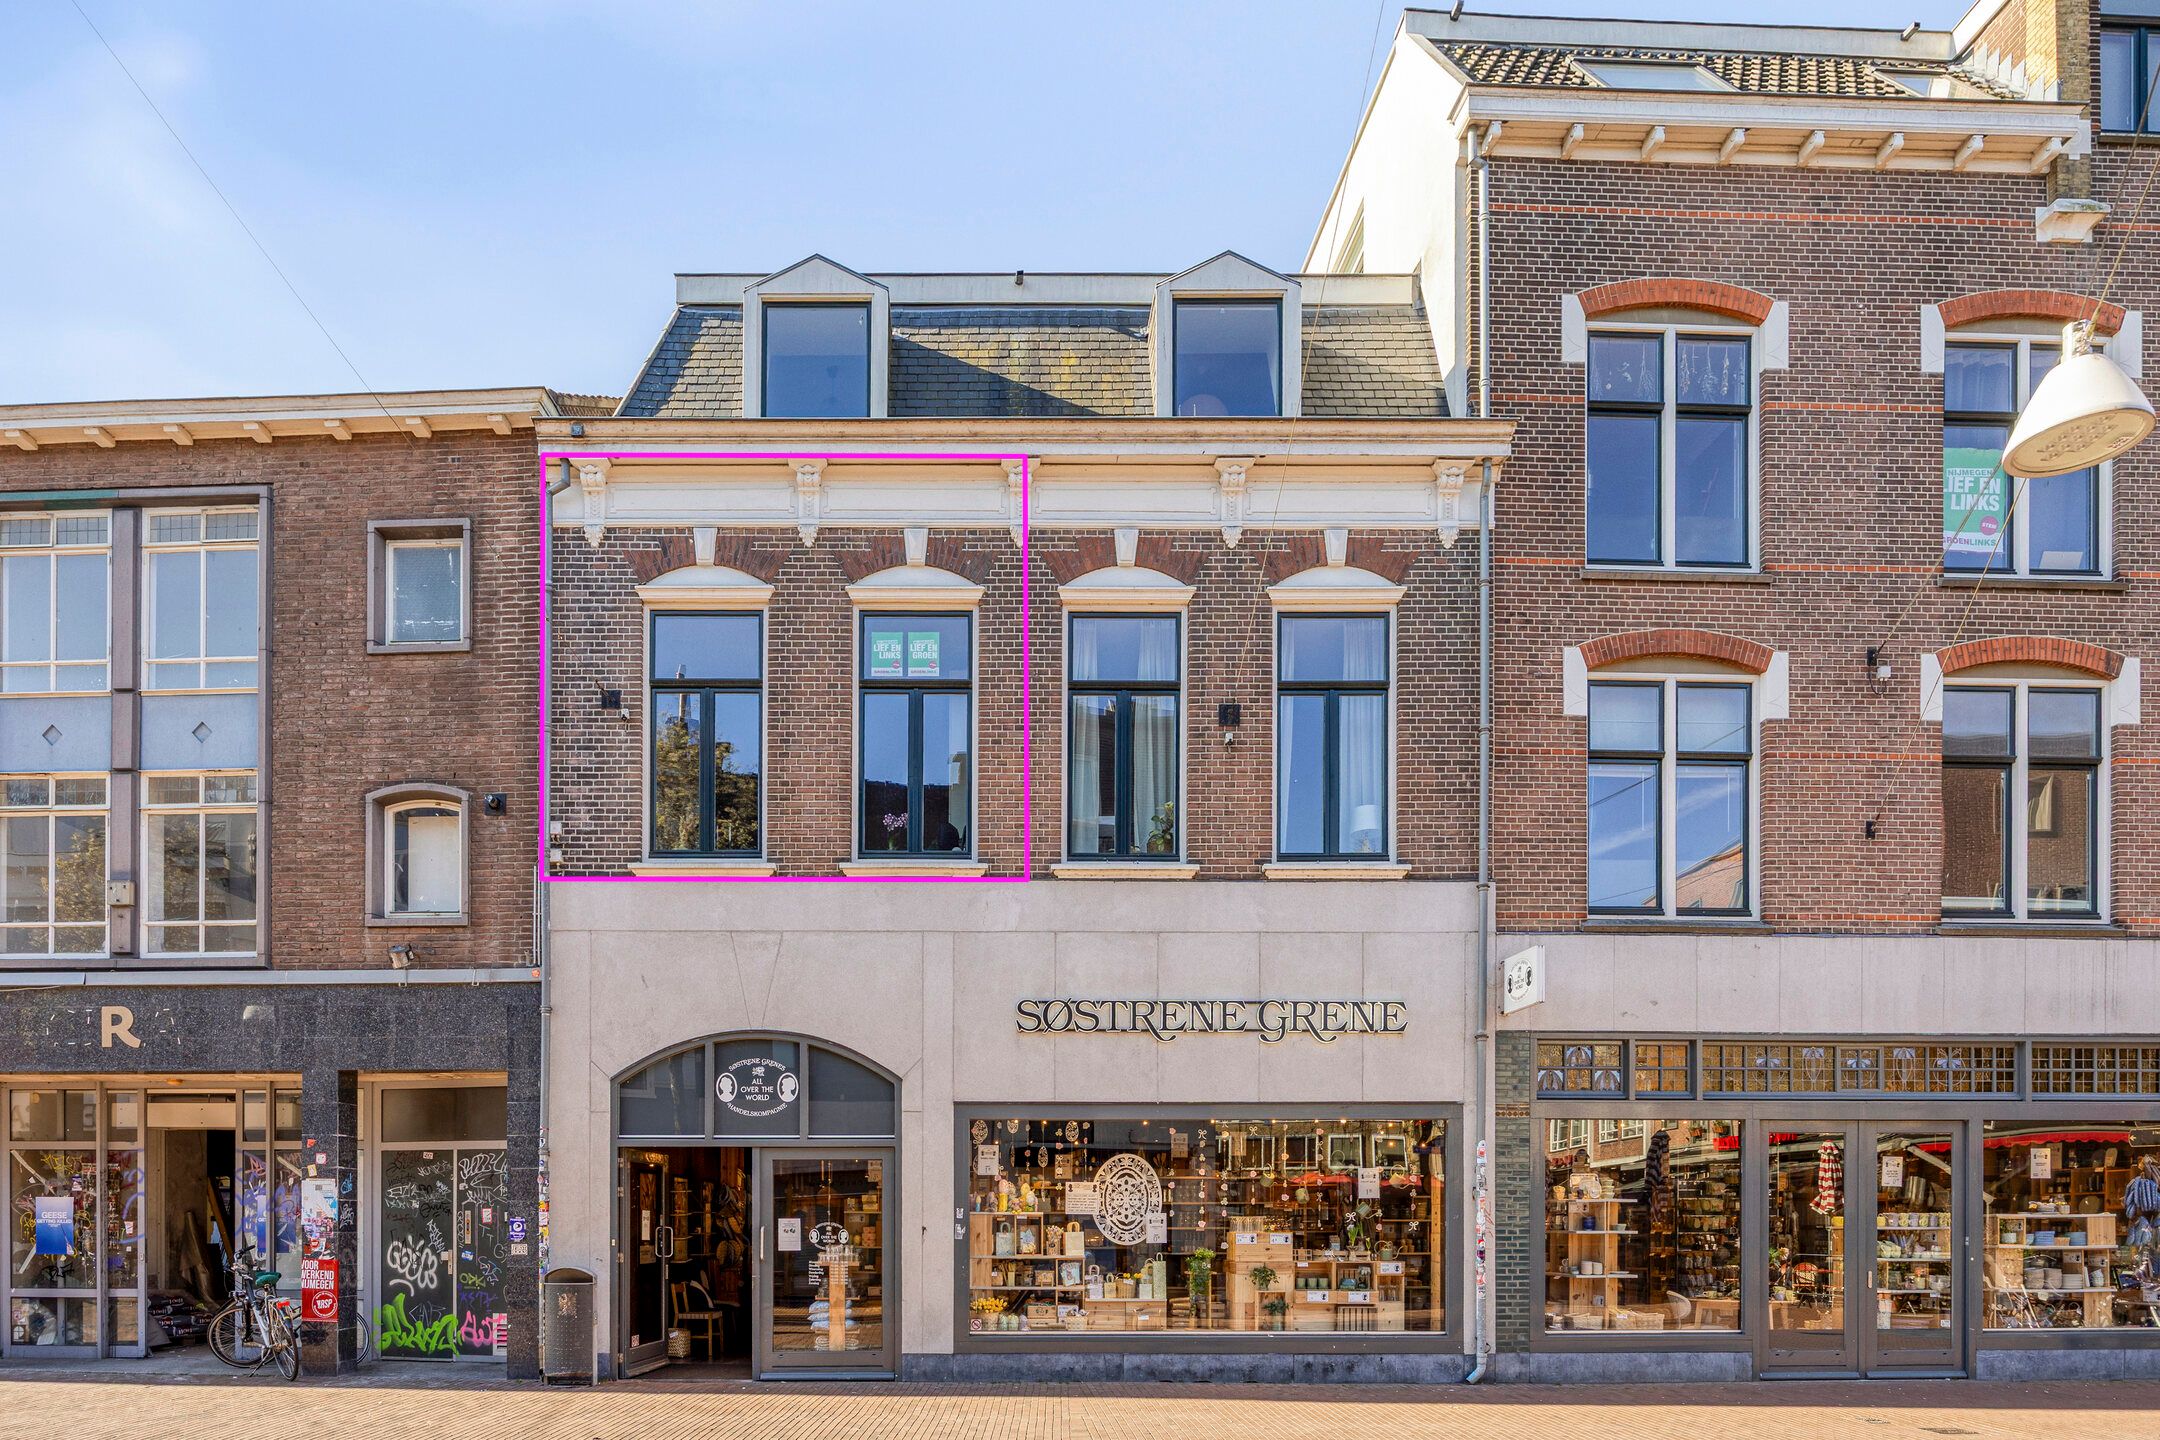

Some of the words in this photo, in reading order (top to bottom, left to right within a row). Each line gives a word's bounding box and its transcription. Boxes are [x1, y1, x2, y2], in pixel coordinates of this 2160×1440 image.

[1943, 476, 1974, 493] IEF
[1979, 477, 2001, 494] EN
[1951, 493, 2000, 511] LINKS
[873, 644, 889, 652] LIEF
[891, 644, 901, 652] EN
[910, 644, 926, 652] LIEF
[927, 644, 938, 652] EN
[101, 1005, 142, 1048] R
[1015, 997, 1248, 1043] SØSTRENE
[1256, 999, 1409, 1043] GRENE
[728, 1057, 761, 1072] SØSTRENE
[761, 1058, 787, 1072] GRENES
[726, 1102, 788, 1117] HANDELSKOMPAGNIE
[41, 1211, 68, 1219] GEESE
